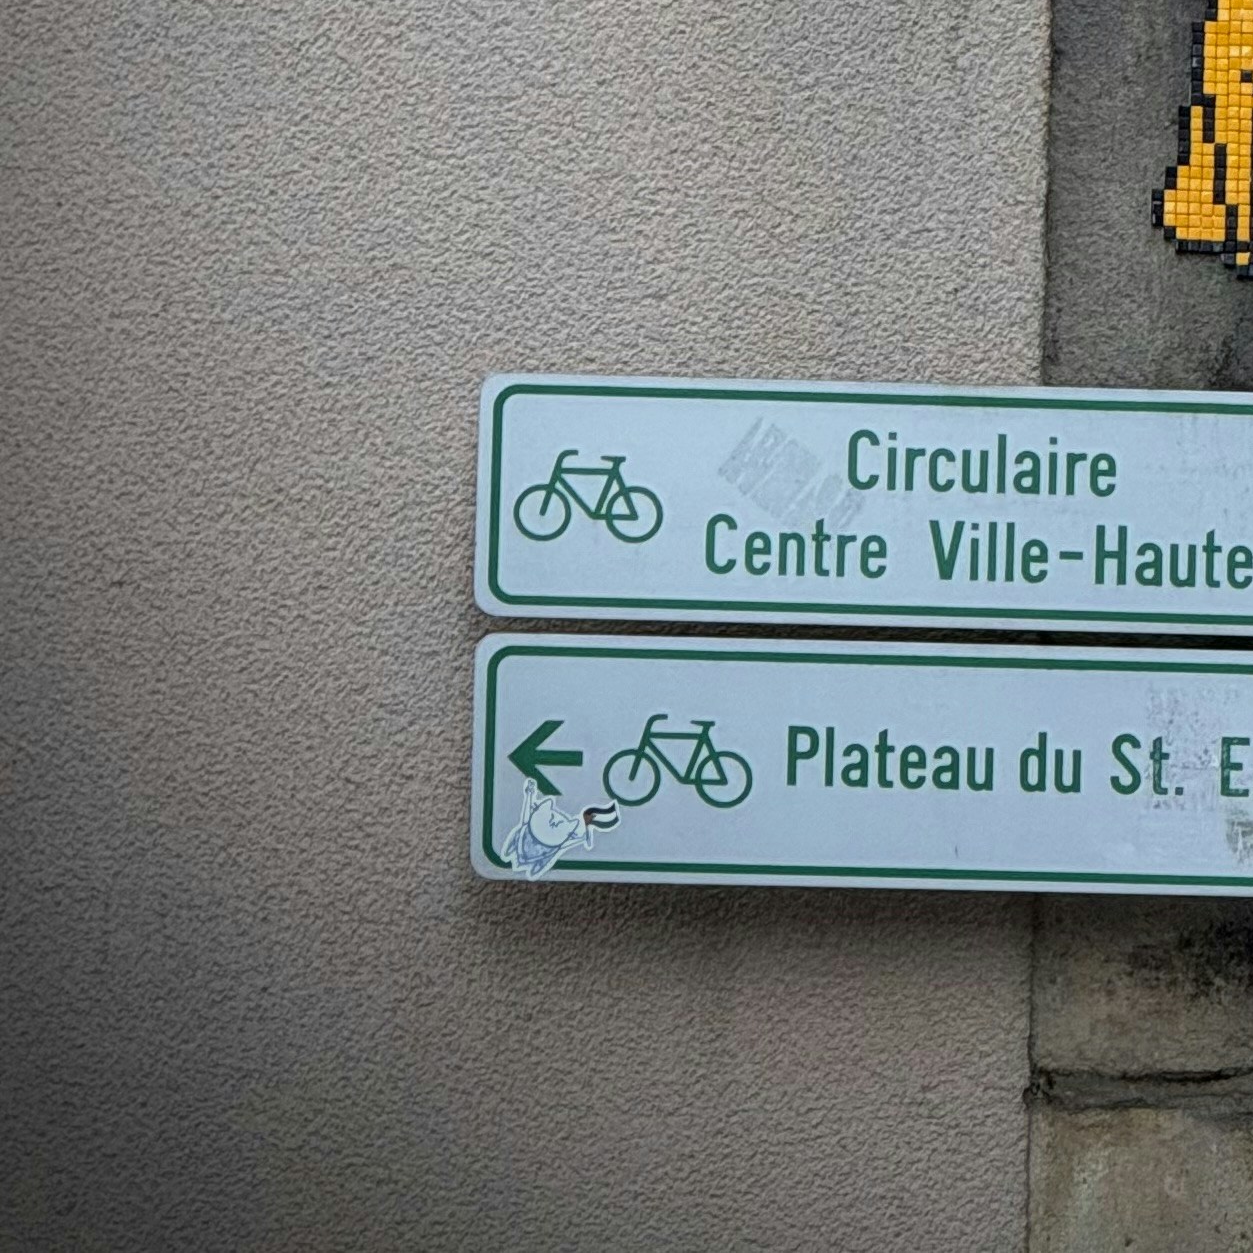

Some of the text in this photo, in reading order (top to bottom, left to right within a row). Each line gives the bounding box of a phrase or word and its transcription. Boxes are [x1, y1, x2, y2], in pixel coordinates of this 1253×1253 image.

[847, 429, 1117, 498] Circulaire
[705, 513, 1253, 590] Centre Ville-Haute
[786, 724, 995, 792] Plateau
[1019, 732, 1082, 795] du
[1109, 733, 1184, 797] St.
